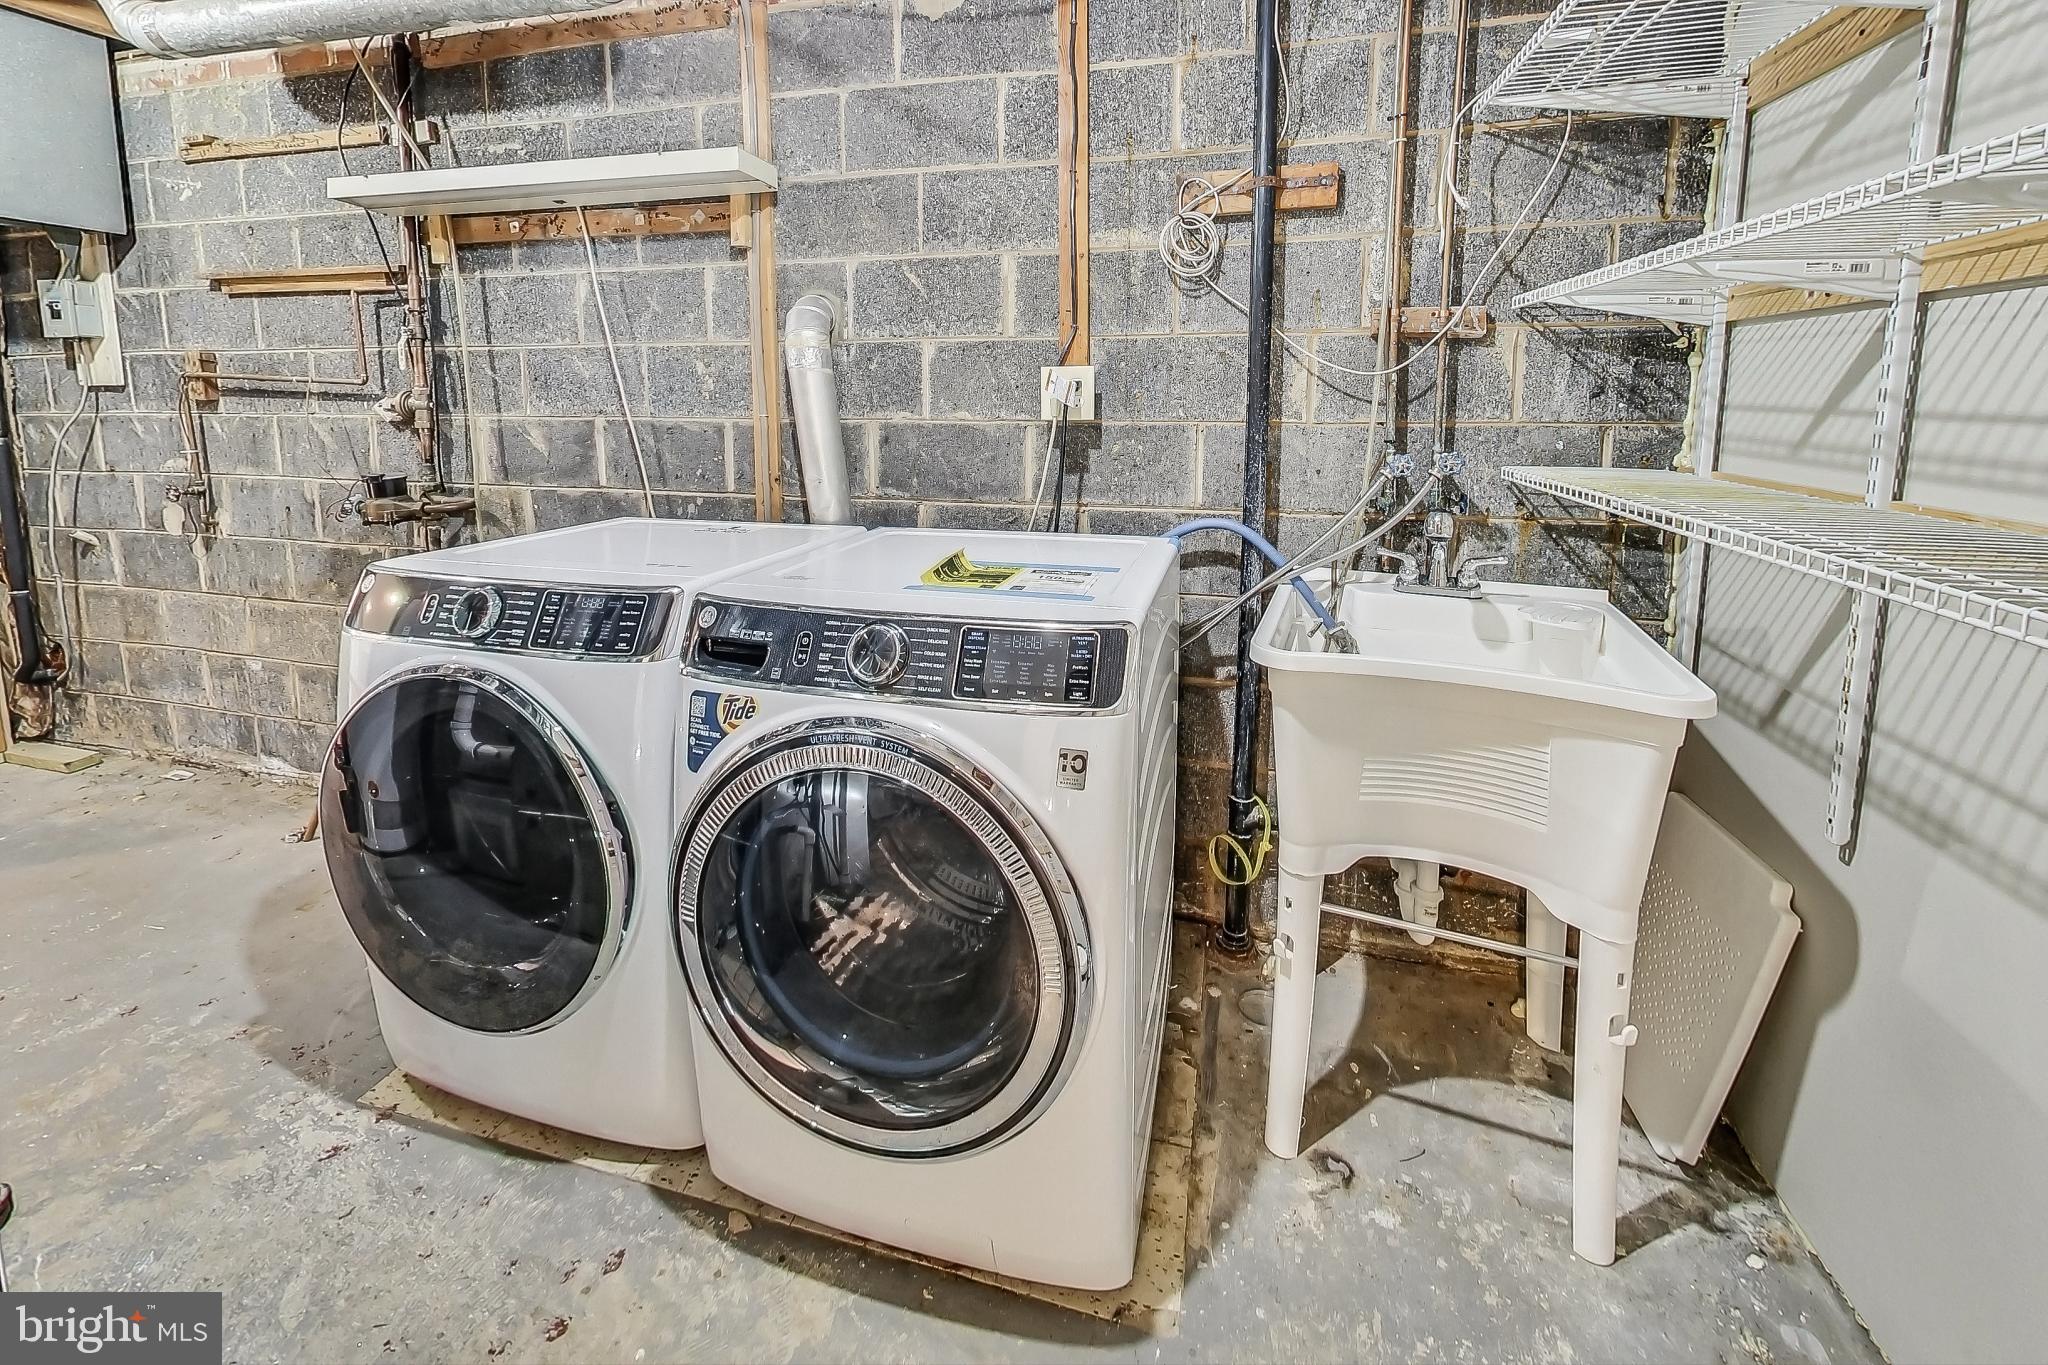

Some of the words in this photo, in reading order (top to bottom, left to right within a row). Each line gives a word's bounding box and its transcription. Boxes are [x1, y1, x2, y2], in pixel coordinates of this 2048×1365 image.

[723, 696, 757, 724] Tide
[880, 740, 909, 755] SYSTEM
[1060, 753, 1087, 774] 10
